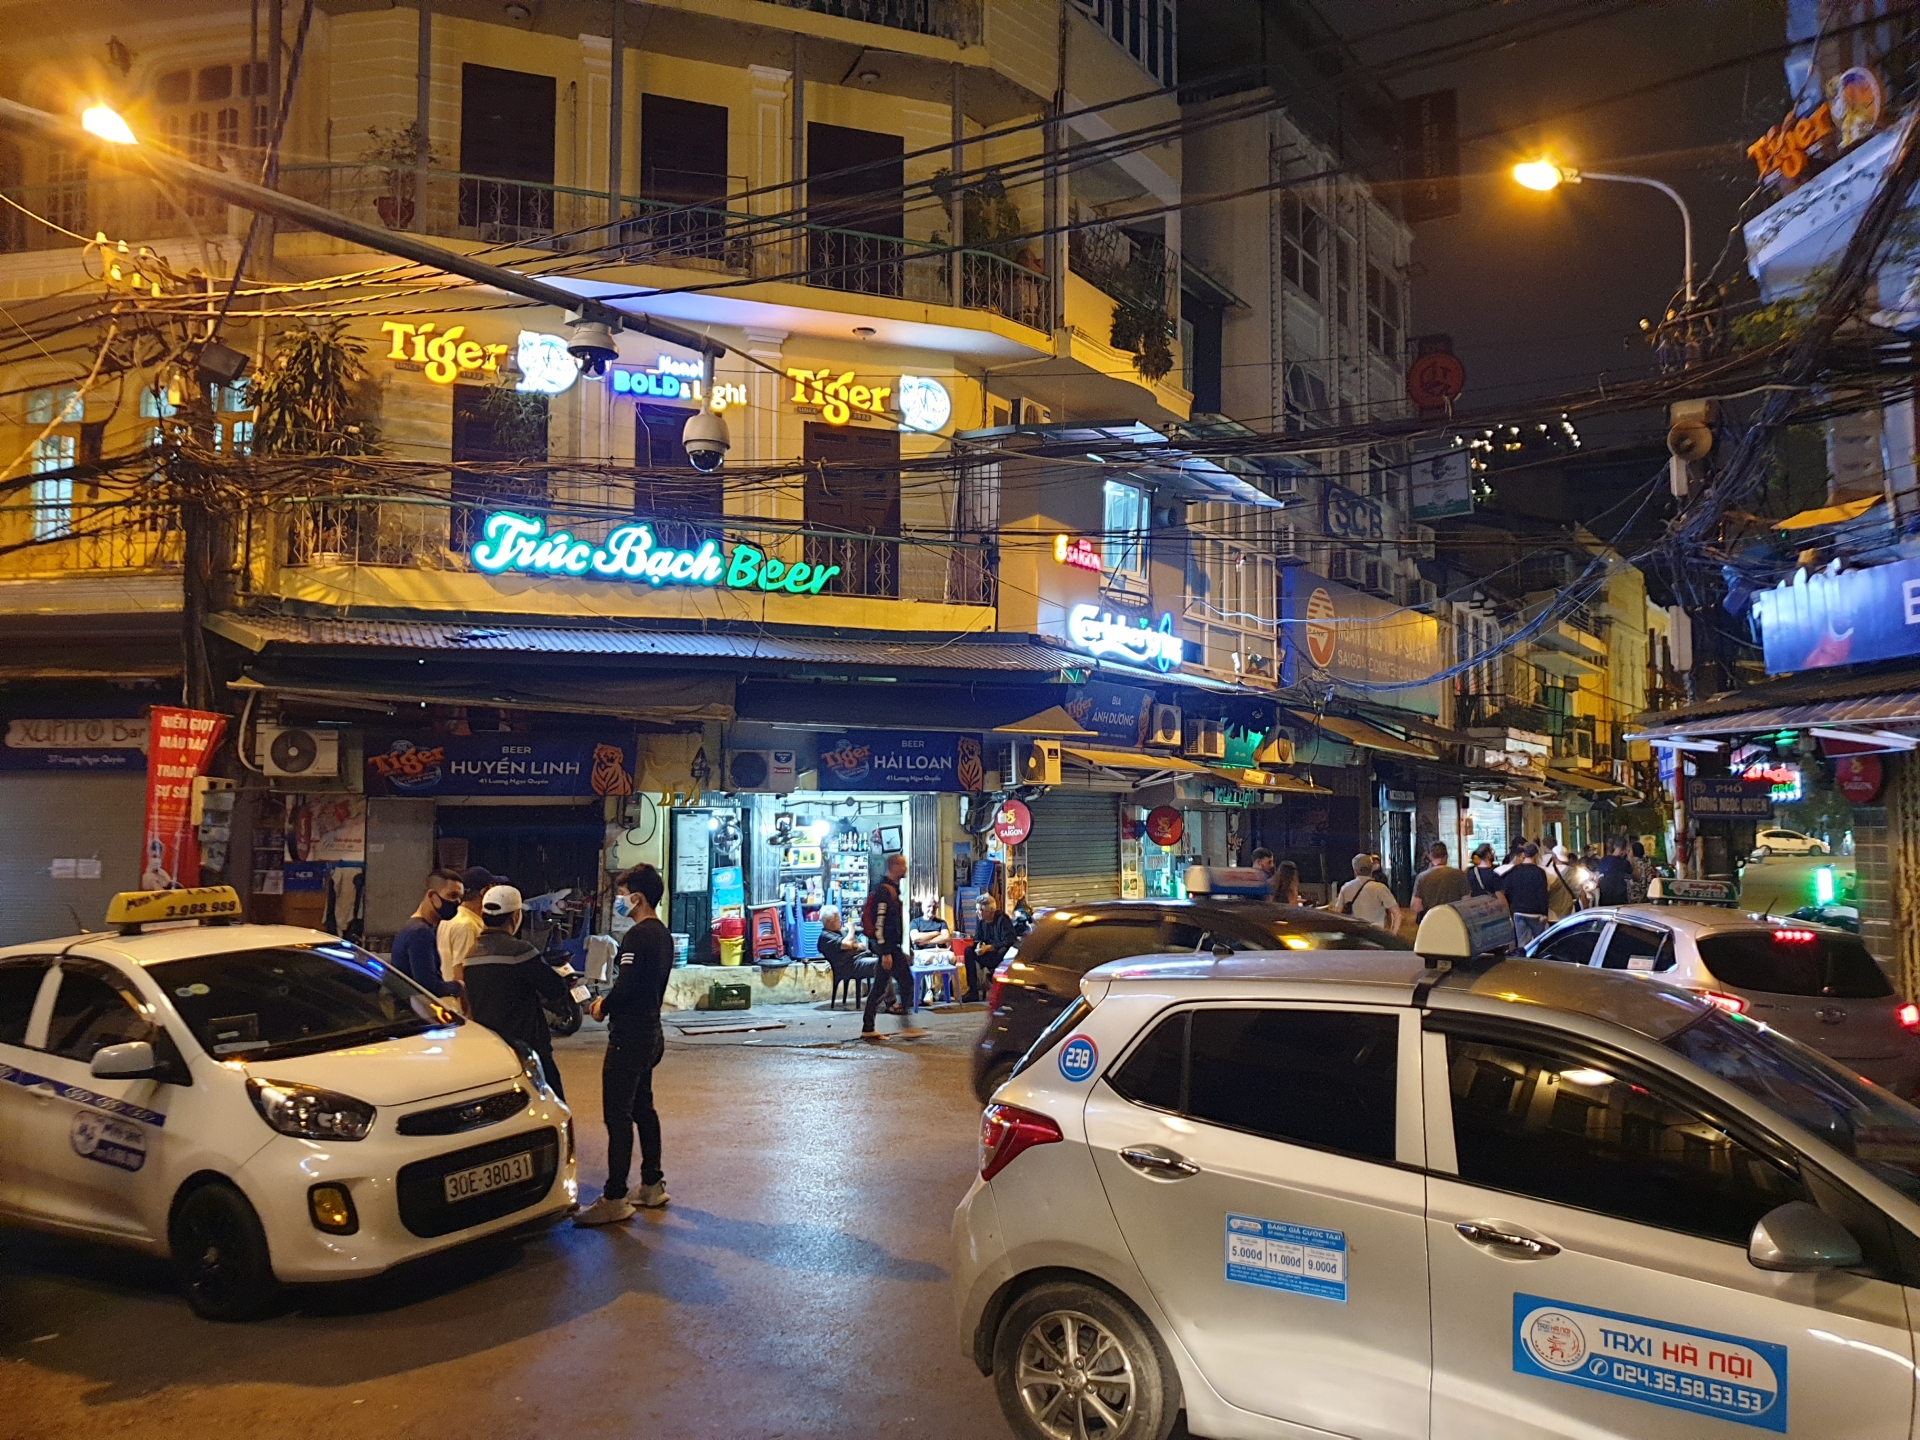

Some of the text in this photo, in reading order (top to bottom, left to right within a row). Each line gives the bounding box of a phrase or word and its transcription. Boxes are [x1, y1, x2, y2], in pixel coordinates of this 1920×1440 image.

[381, 321, 509, 384] Tiger
[613, 369, 681, 398] BOLD
[692, 379, 748, 412] Lght
[786, 367, 892, 425] Tiger
[474, 512, 841, 595] Trúc Bạch Beer
[502, 746, 532, 754] BEER
[821, 744, 871, 772] Tiger
[902, 740, 925, 748] BEER
[367, 747, 445, 776] Tiger
[530, 761, 580, 775] LINH
[874, 751, 952, 769] HẢI LOAN
[1000, 829, 1024, 837] SAIGON
[1065, 1047, 1090, 1069] 238
[448, 1155, 530, 1198] 30E-380.31
[1325, 1232, 1341, 1241] TAXI
[1231, 1245, 1263, 1261] 5.000đ
[1268, 1252, 1302, 1268] 11.000đ
[1307, 1259, 1337, 1274] 9.000đ
[1599, 1327, 1753, 1379] TAXI HÀ NỘI
[1612, 1362, 1763, 1411] 024.35.58.53.53
